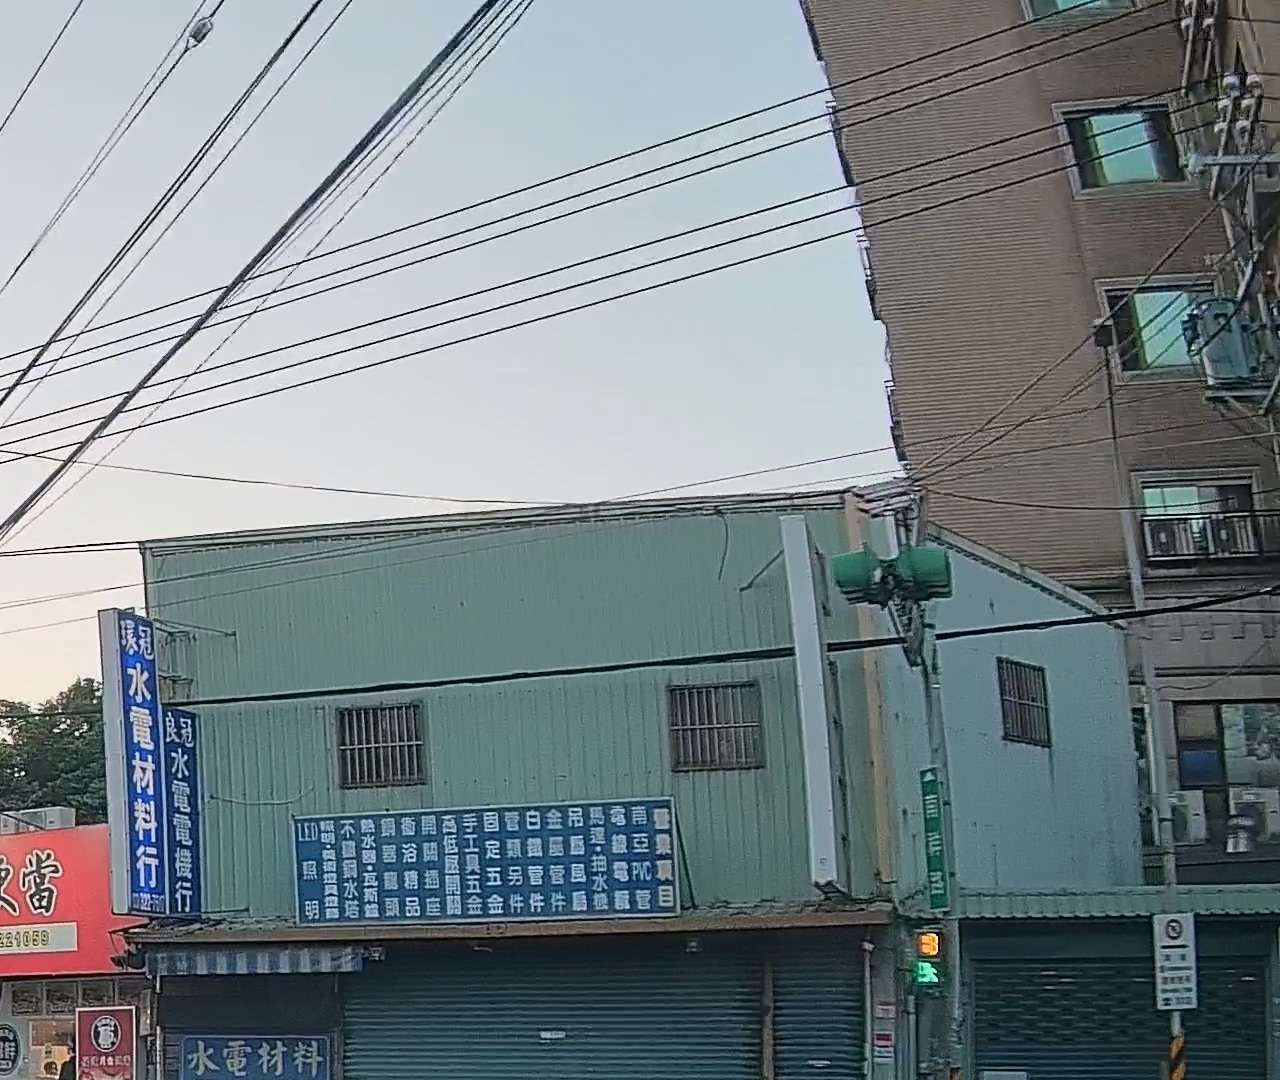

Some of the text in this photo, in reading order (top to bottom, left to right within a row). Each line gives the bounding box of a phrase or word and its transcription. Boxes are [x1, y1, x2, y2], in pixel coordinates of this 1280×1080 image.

[127, 662, 160, 889] 水電材料行
[170, 748, 194, 913] 水電電機行
[462, 813, 483, 914] 手工具五金
[483, 811, 504, 914] 固定五金
[188, 1040, 325, 1077] 水電材料
